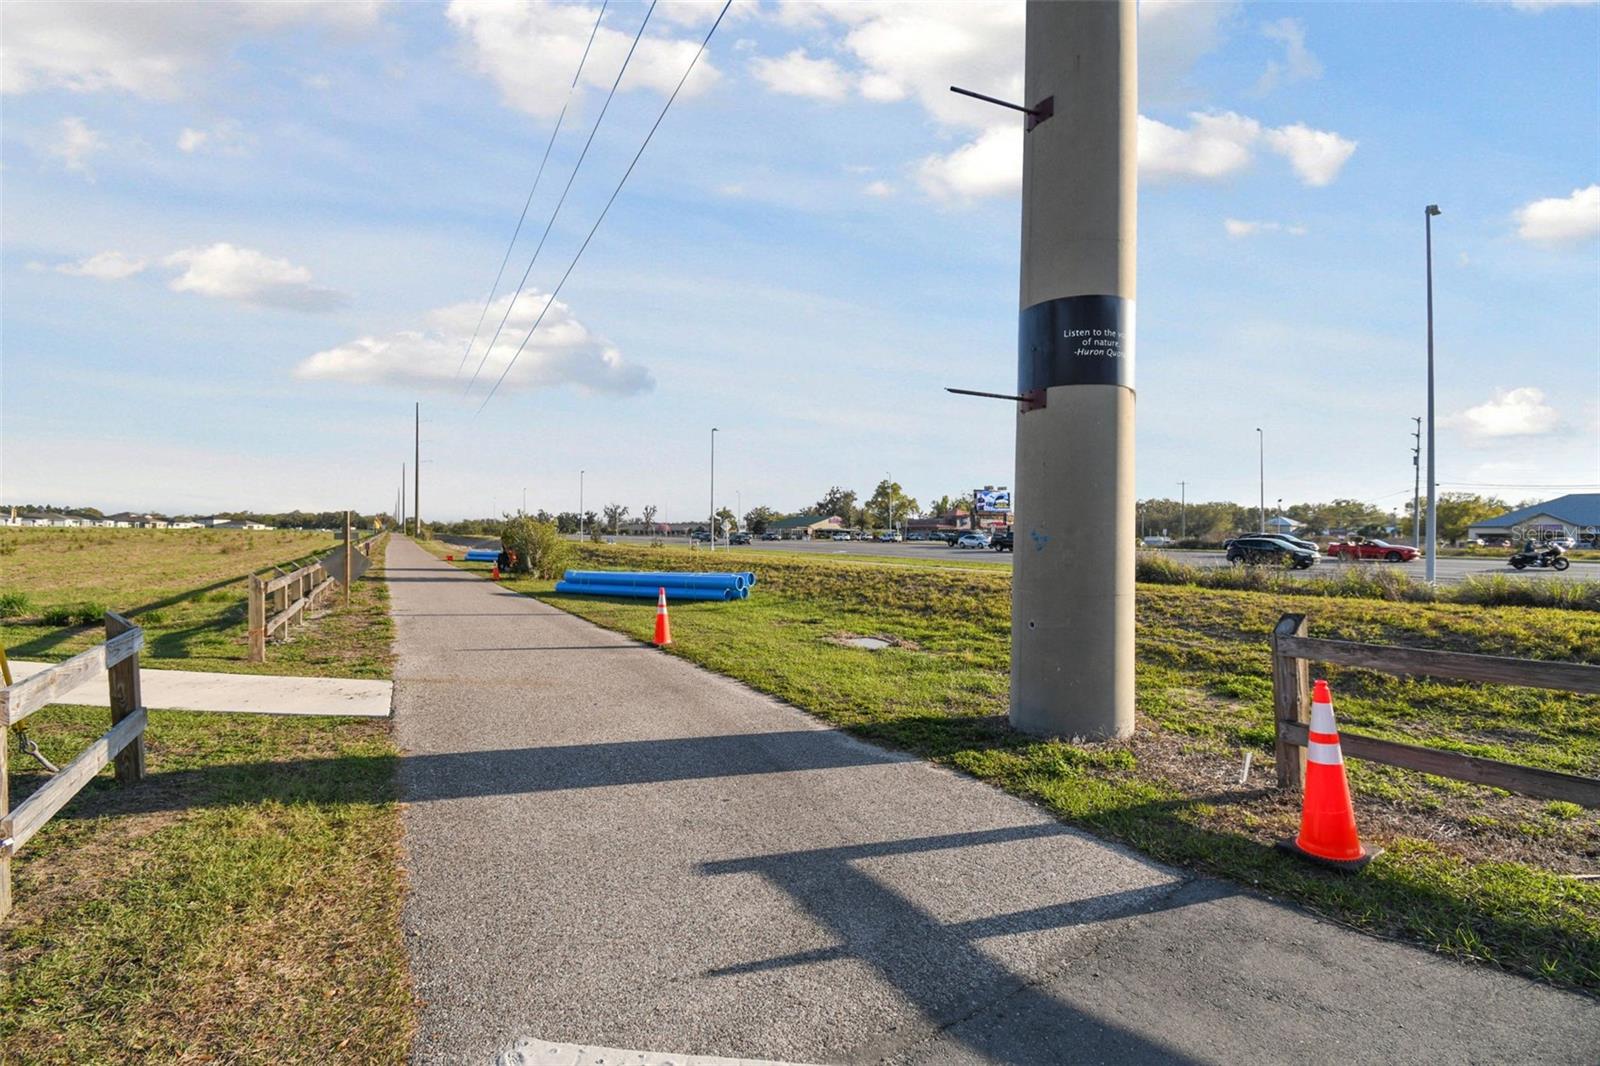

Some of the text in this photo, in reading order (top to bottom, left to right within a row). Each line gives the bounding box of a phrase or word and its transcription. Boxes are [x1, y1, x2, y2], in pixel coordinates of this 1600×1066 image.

[1063, 329, 1091, 338] Listen
[1104, 329, 1117, 338] the
[1082, 337, 1092, 346] of
[1074, 348, 1104, 356] -Huron
